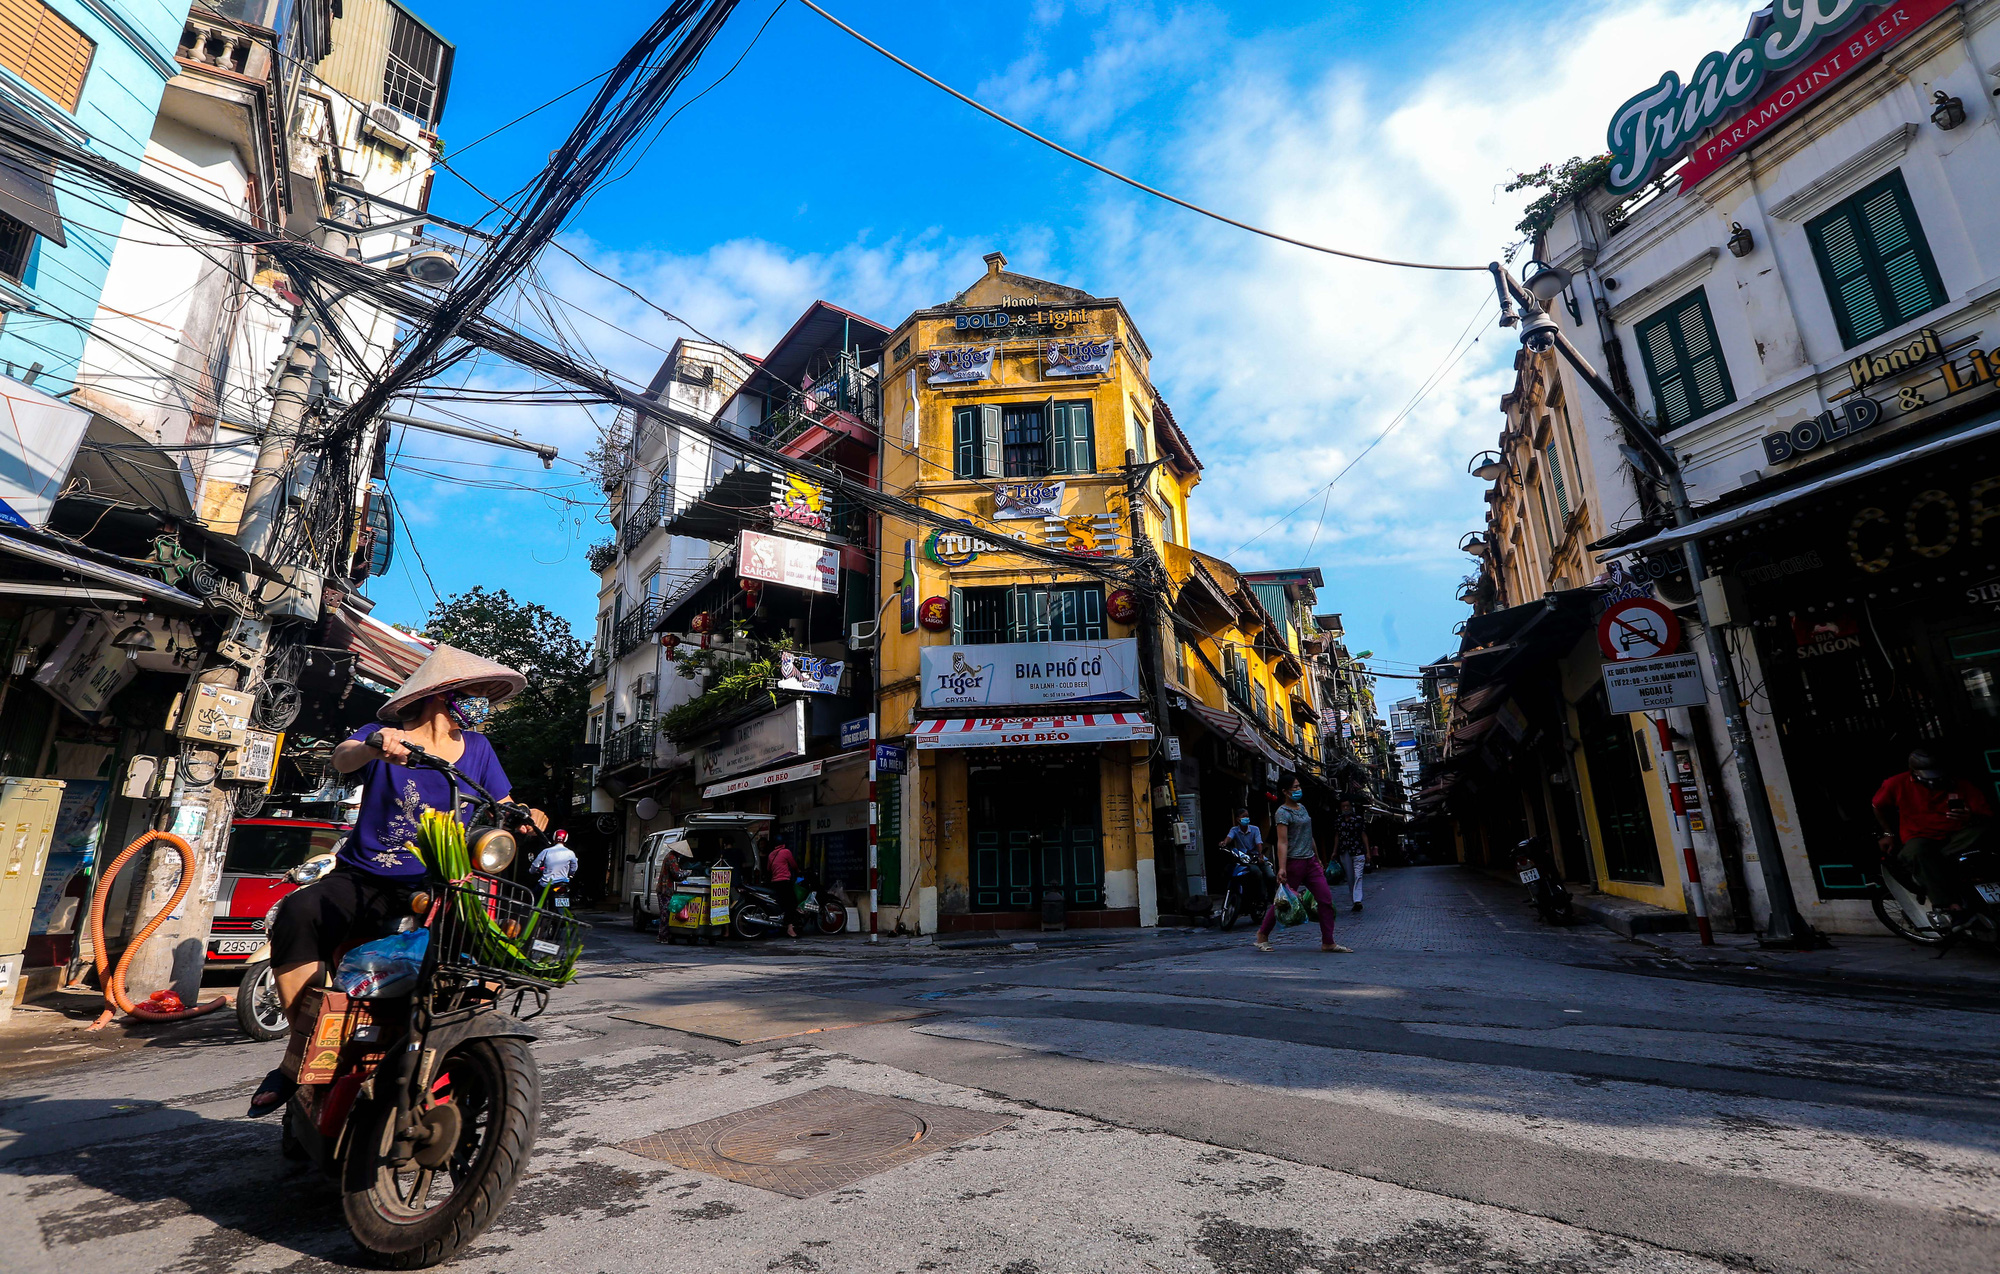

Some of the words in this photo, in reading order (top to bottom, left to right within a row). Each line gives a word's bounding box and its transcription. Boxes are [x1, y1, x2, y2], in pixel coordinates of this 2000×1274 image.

[1706, 53, 1843, 161] PARAMOUNT
[1848, 8, 1910, 59] BEER
[1610, 47, 1754, 187] Trúc
[1001, 294, 1038, 309] Hanoi
[955, 312, 1010, 331] BOLD
[1017, 314, 1027, 326] &
[1036, 308, 1089, 330] Light
[944, 347, 990, 369] Tiger
[1064, 340, 1110, 363] Tiger
[1851, 328, 1940, 389] Hanoi
[1762, 397, 1881, 466] BOLD
[1898, 386, 1925, 412] &
[1013, 481, 1060, 505] Tiger
[744, 565, 779, 580] SAIGON
[1740, 550, 1824, 586] TUBORG
[925, 616, 944, 624] SAIGON
[1796, 635, 1862, 659] SAIGON
[1815, 633, 1835, 643] BIA
[798, 657, 841, 680] Tiger
[1015, 662, 1044, 679] BIA
[1046, 656, 1078, 678] PHỐ
[1081, 654, 1102, 677] CỔ
[1615, 667, 1629, 675] QUÉT
[1630, 665, 1648, 674] ĐƯỜNG
[1649, 663, 1664, 672] ĐƯỢC
[1665, 661, 1680, 670] HOẠT
[1680, 658, 1696, 667] ĐỘNG
[1661, 672, 1675, 681] HÀNG
[937, 673, 984, 696] Tiger
[1041, 682, 1055, 690] LẠNH
[1639, 685, 1662, 697] NGOẠI
[1664, 683, 1674, 695] LỆ
[945, 696, 977, 704] CRYSTAL
[1643, 696, 1674, 706] Except
[1001, 735, 1029, 744] LỢI
[1035, 731, 1070, 742] BÉO
[817, 818, 830, 829] BOLD
